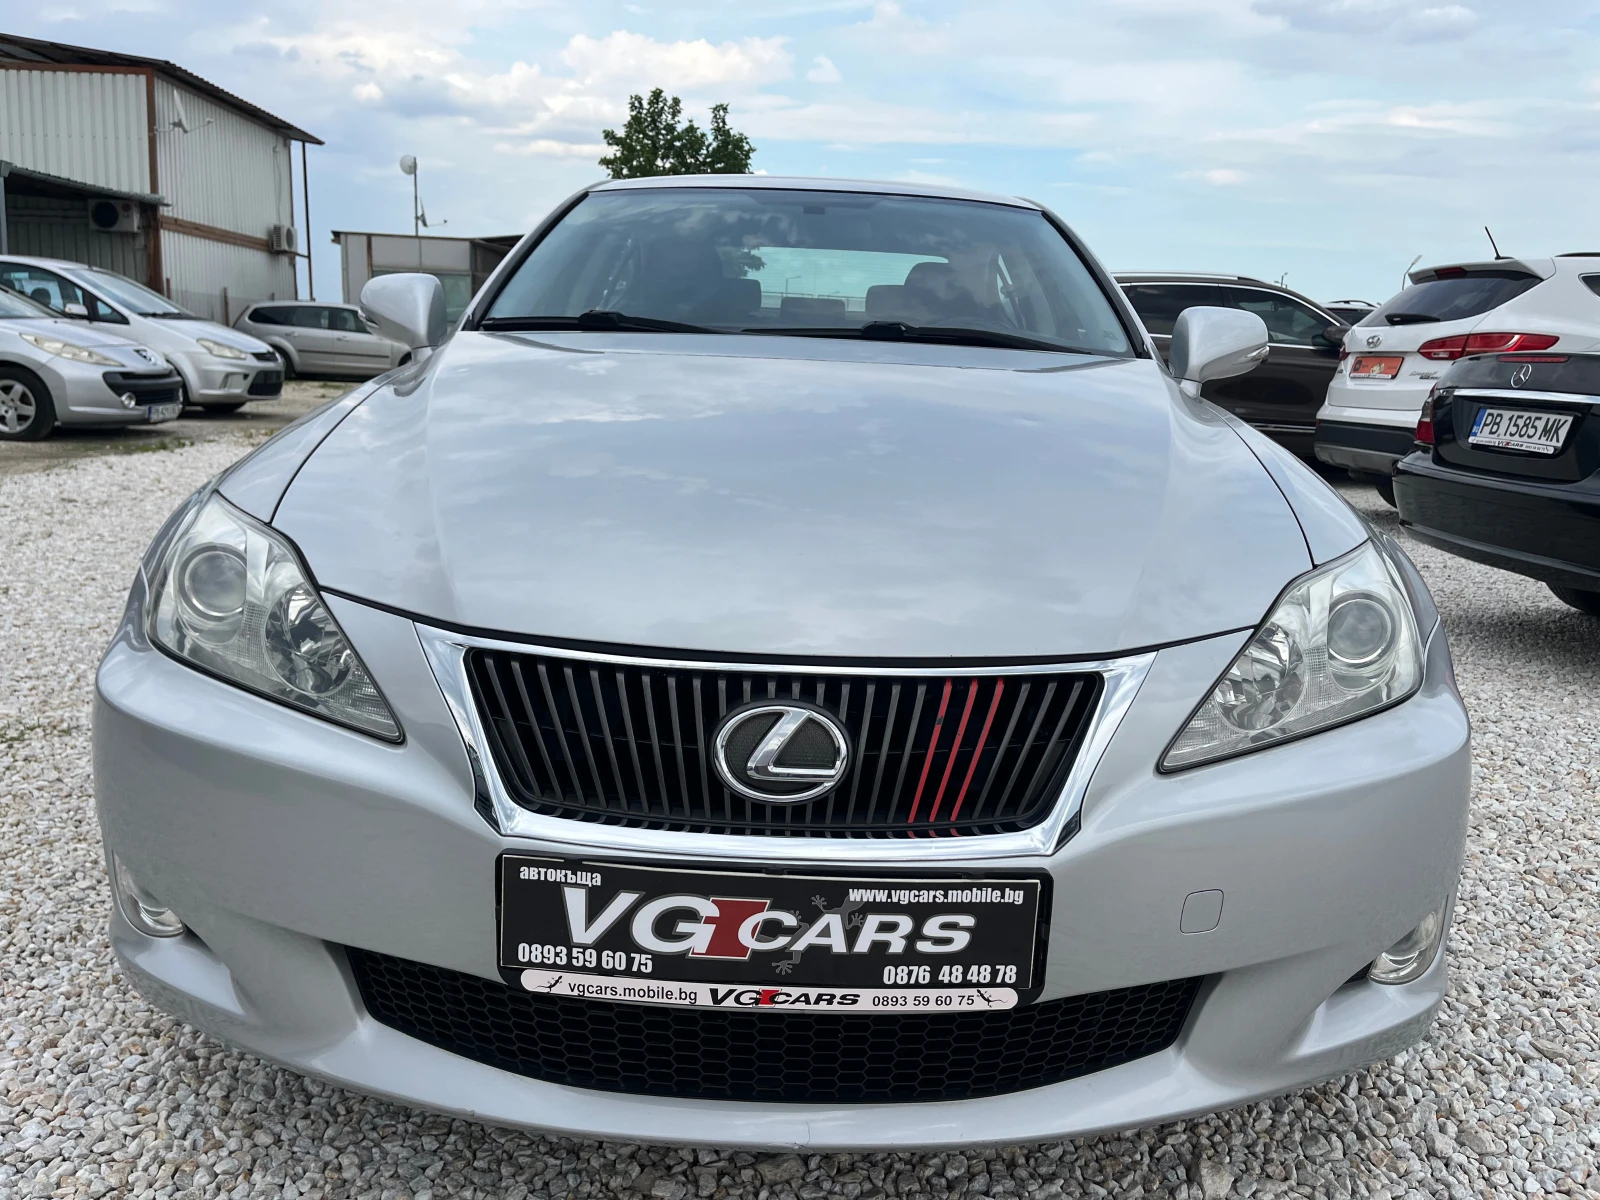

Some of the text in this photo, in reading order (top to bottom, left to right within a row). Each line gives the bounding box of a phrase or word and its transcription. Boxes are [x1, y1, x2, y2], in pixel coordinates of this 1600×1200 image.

[1480, 412, 1568, 443] PB 1585 MK
[519, 866, 602, 887] автокъща
[849, 888, 1024, 905] www.vgcars.mobile.bg
[518, 943, 653, 973] 0893 59 60 75
[883, 965, 1017, 985] 0876 48 48 78
[568, 982, 698, 1004] vgcars.mobile.bg
[872, 995, 909, 1007] 0893
[912, 996, 930, 1007] 59
[935, 996, 954, 1007] 60
[957, 995, 975, 1006] 75
